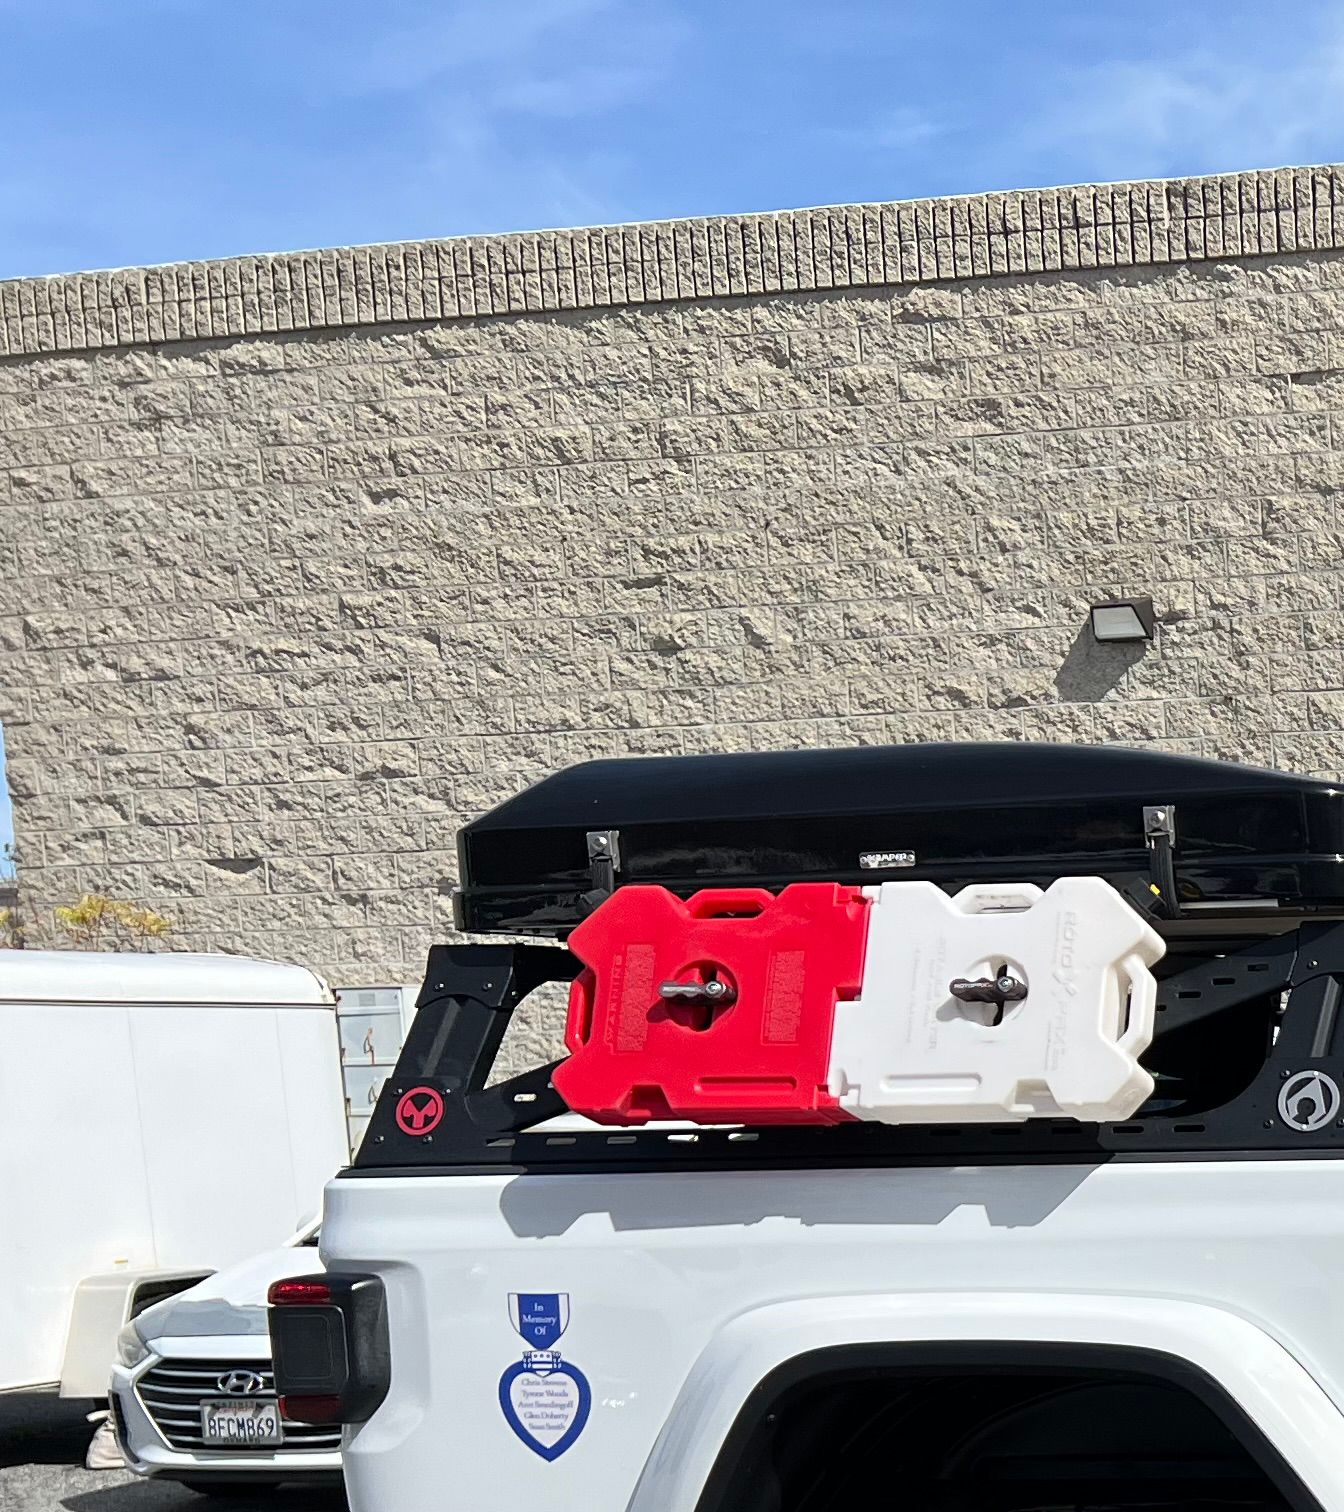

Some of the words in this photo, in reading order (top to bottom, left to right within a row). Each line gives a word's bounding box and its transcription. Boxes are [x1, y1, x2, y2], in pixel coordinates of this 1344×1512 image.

[534, 1302, 544, 1311] In
[522, 1314, 557, 1326] Memory
[534, 1326, 547, 1335] Of
[208, 1417, 274, 1438] 8FCM869
